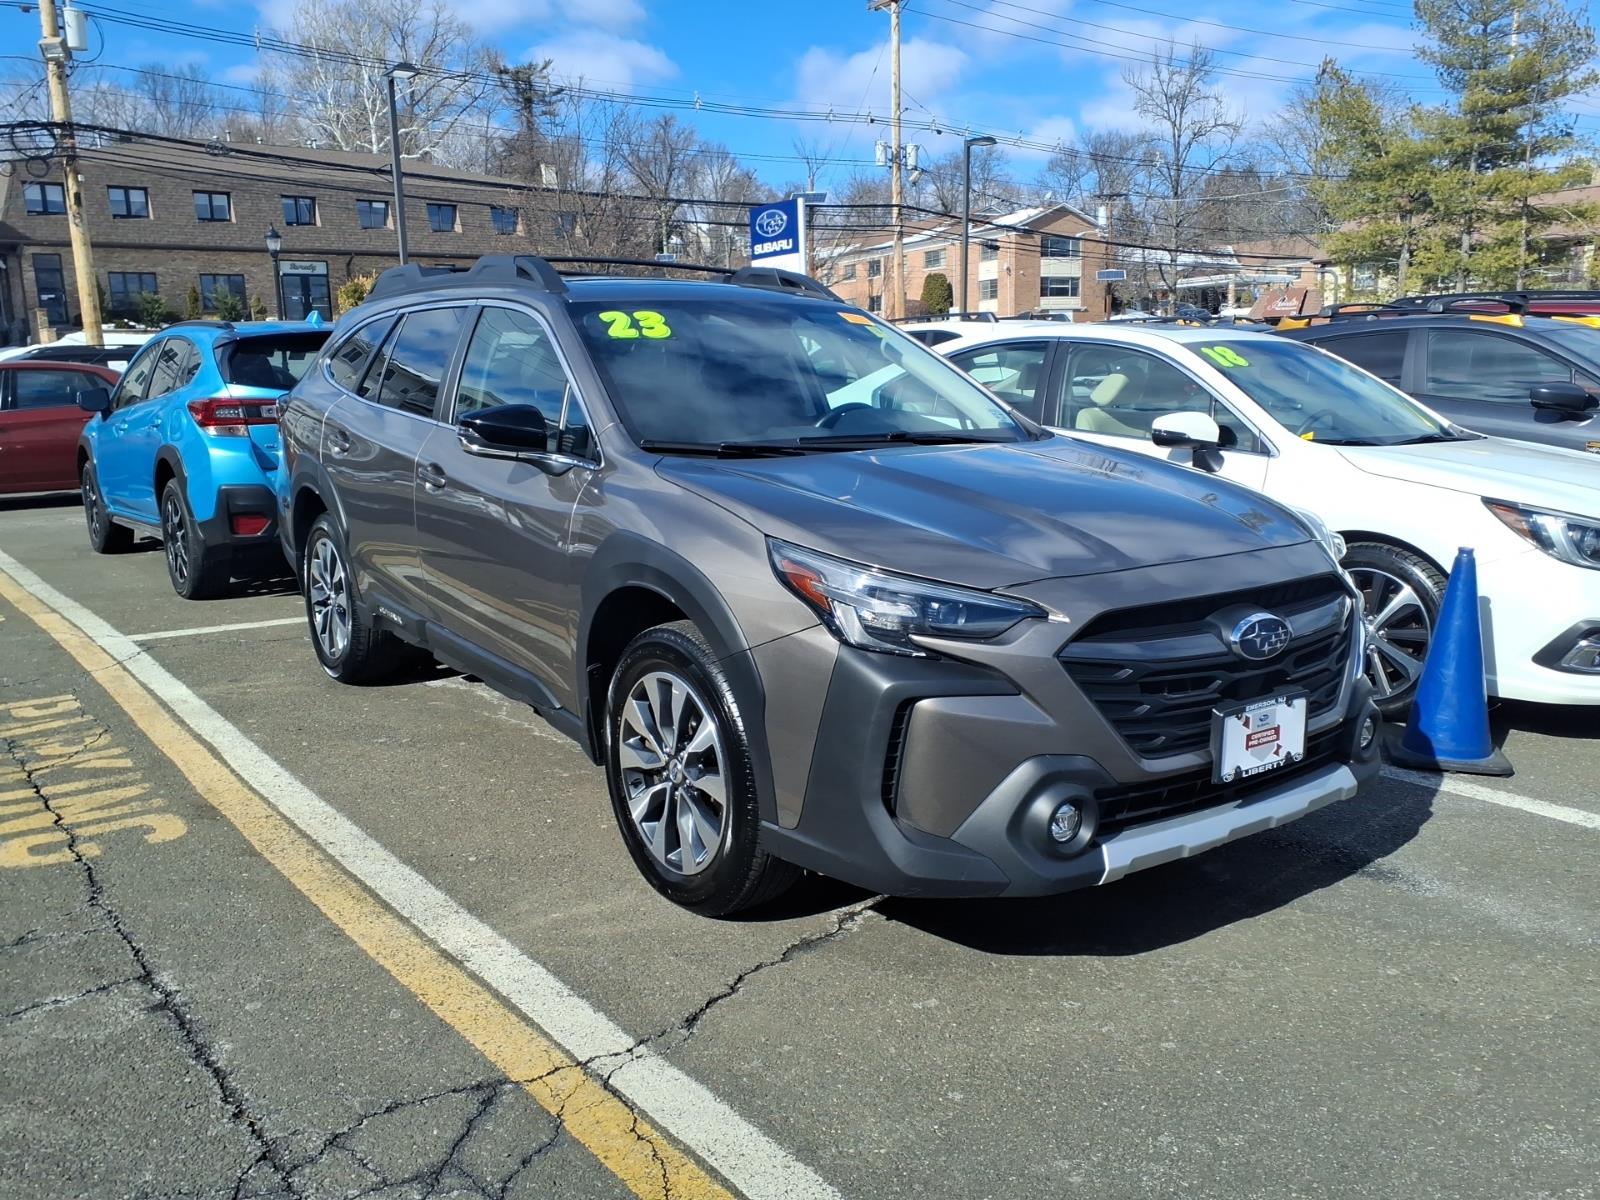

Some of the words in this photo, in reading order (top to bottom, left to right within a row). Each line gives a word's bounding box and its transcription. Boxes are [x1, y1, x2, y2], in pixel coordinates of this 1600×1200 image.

[754, 238, 792, 254] SUBARU
[598, 310, 671, 339] 23
[1200, 346, 1249, 368] 18
[1242, 759, 1286, 777] LIBERTY
